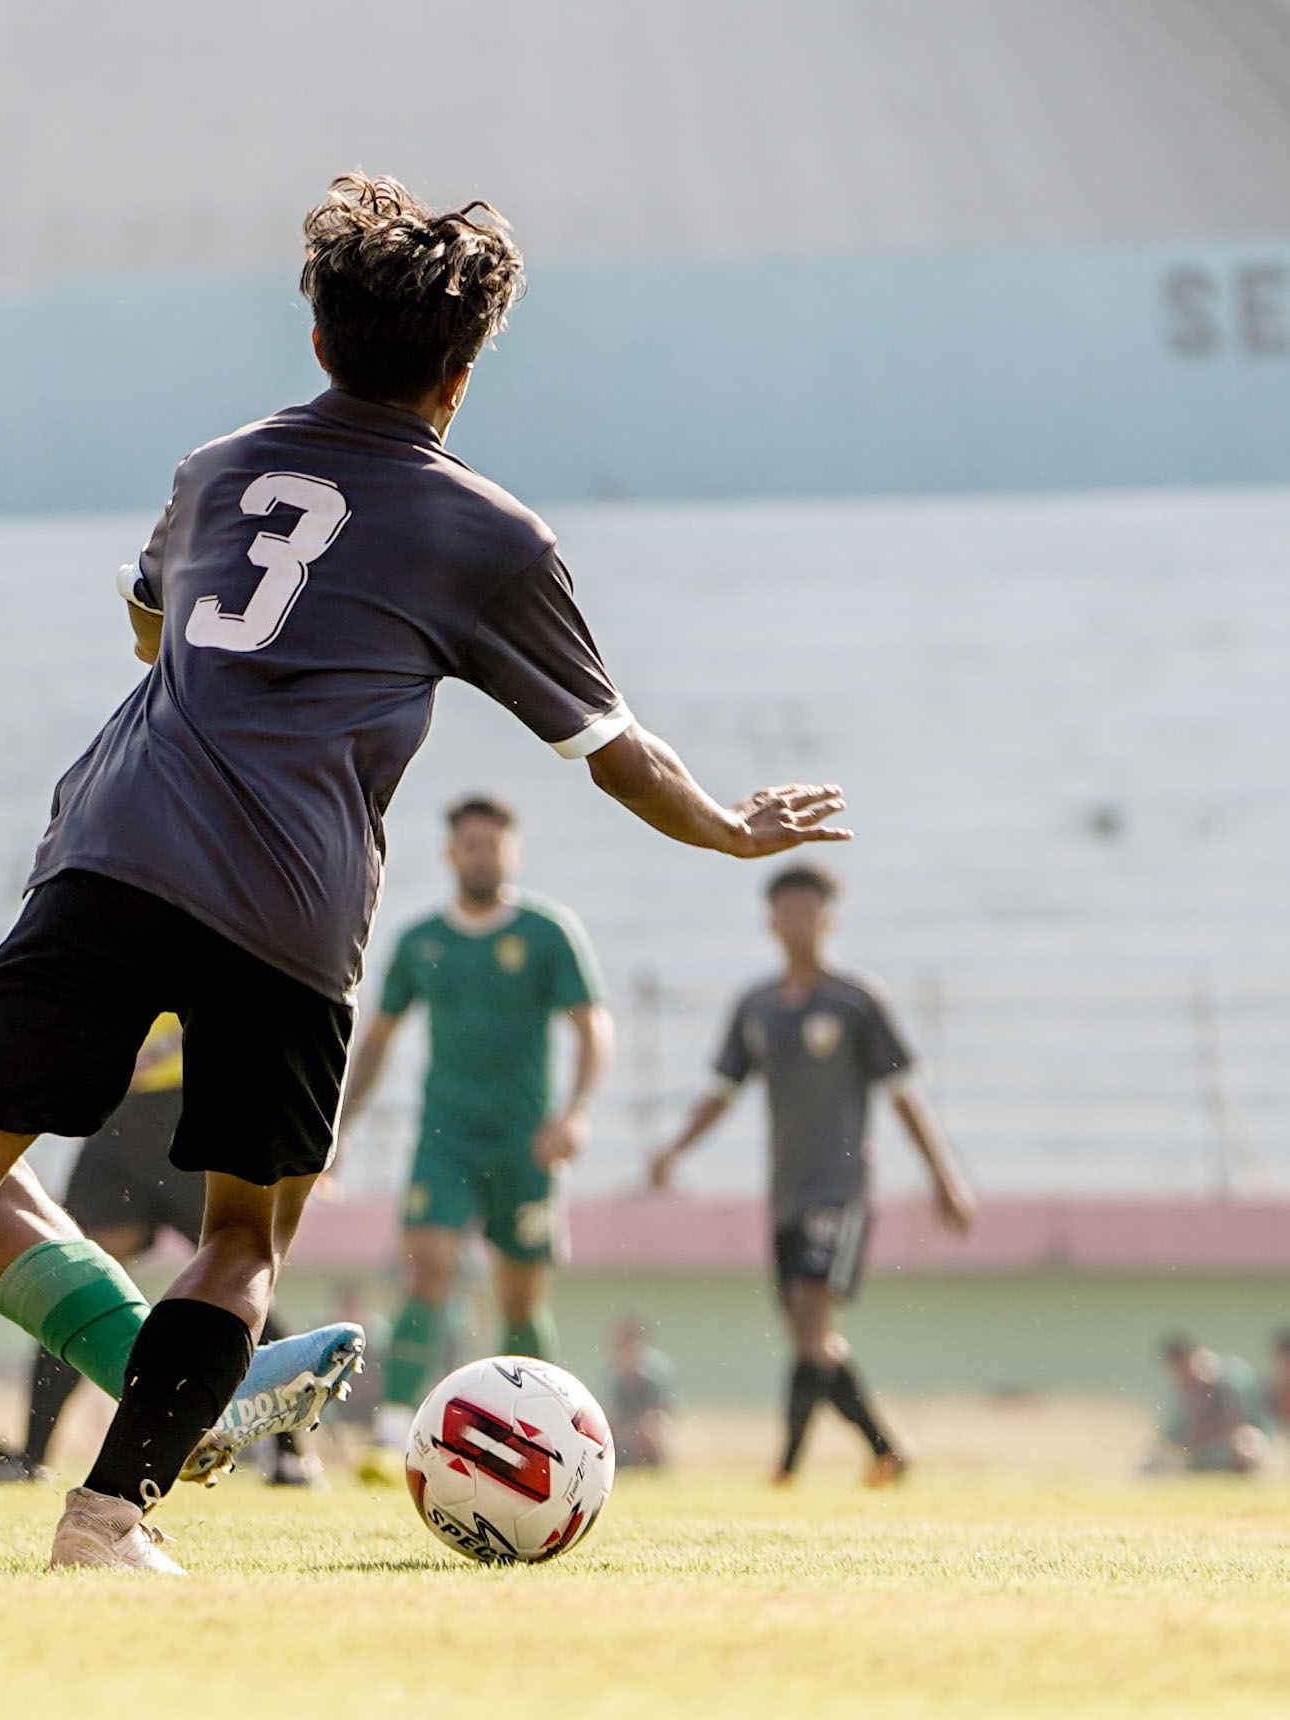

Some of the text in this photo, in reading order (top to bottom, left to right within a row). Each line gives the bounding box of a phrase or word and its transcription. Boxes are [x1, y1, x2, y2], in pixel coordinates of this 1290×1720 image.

[1163, 264, 1290, 357] SE
[185, 471, 353, 652] 3
[236, 1392, 274, 1425] DO
